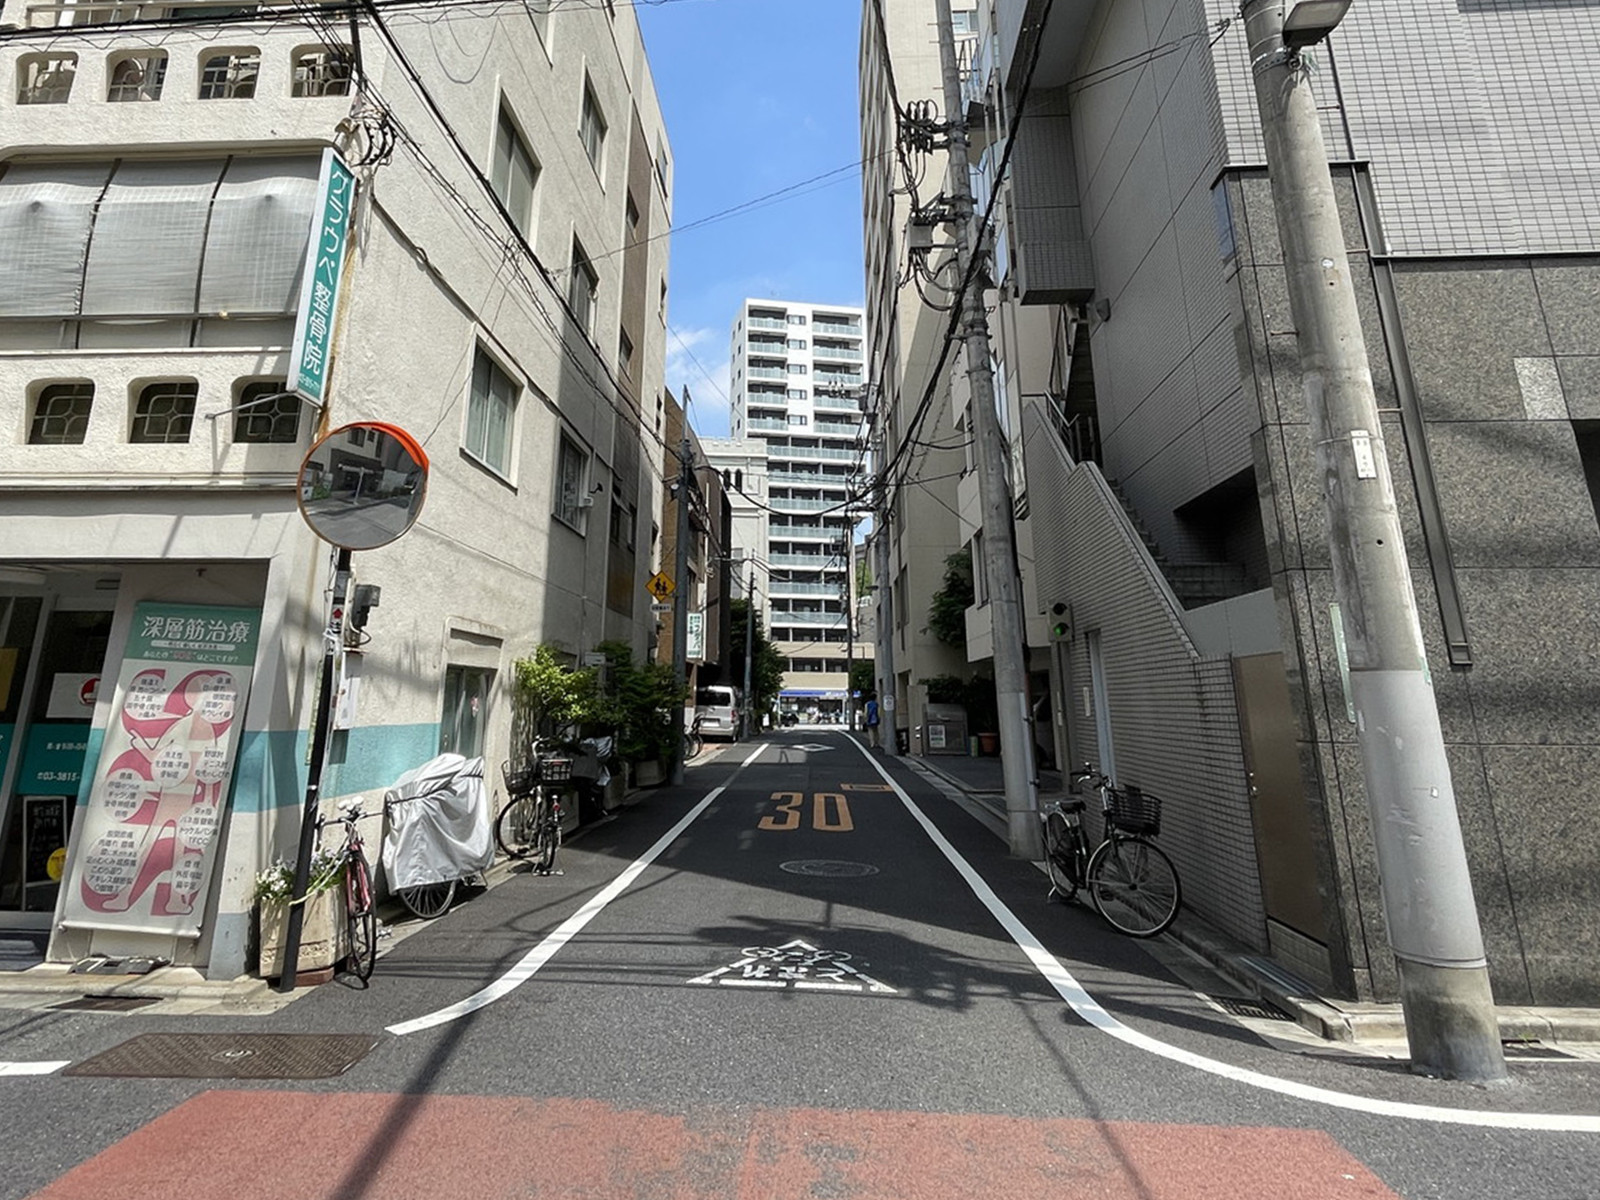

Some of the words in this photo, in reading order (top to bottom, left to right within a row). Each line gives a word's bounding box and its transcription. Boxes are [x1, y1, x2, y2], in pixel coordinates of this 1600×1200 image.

[141, 616, 250, 643] 深層筋治療
[757, 791, 854, 832] 30
